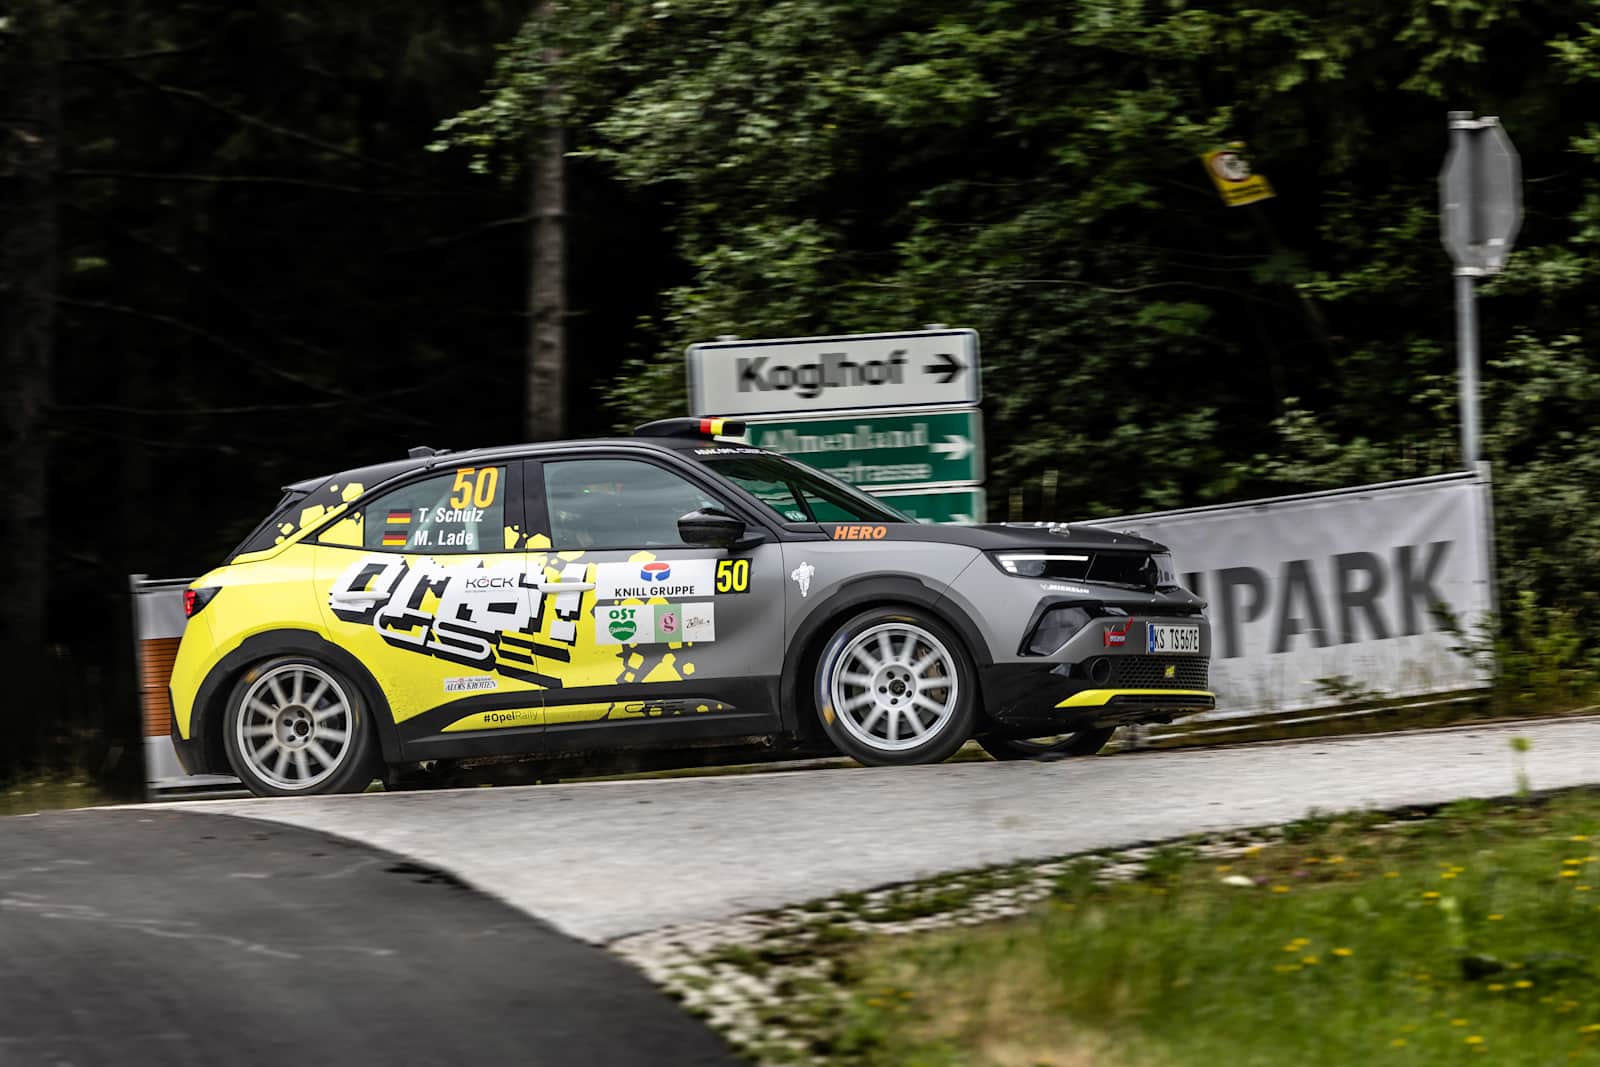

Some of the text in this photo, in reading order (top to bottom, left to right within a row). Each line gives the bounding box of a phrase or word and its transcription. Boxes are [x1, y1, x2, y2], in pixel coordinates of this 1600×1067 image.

[735, 350, 907, 399] Koglhof
[449, 467, 499, 510] 50
[418, 507, 484, 522] T. Schulz
[414, 530, 473, 546] M. Lade
[833, 525, 887, 540] HERO
[465, 575, 514, 589] KÖCK
[716, 560, 749, 592] 50
[615, 585, 695, 598] KNILL GRUPPE
[609, 608, 636, 620] OST
[1154, 628, 1165, 649] KS
[484, 711, 538, 724] #OpelRally
